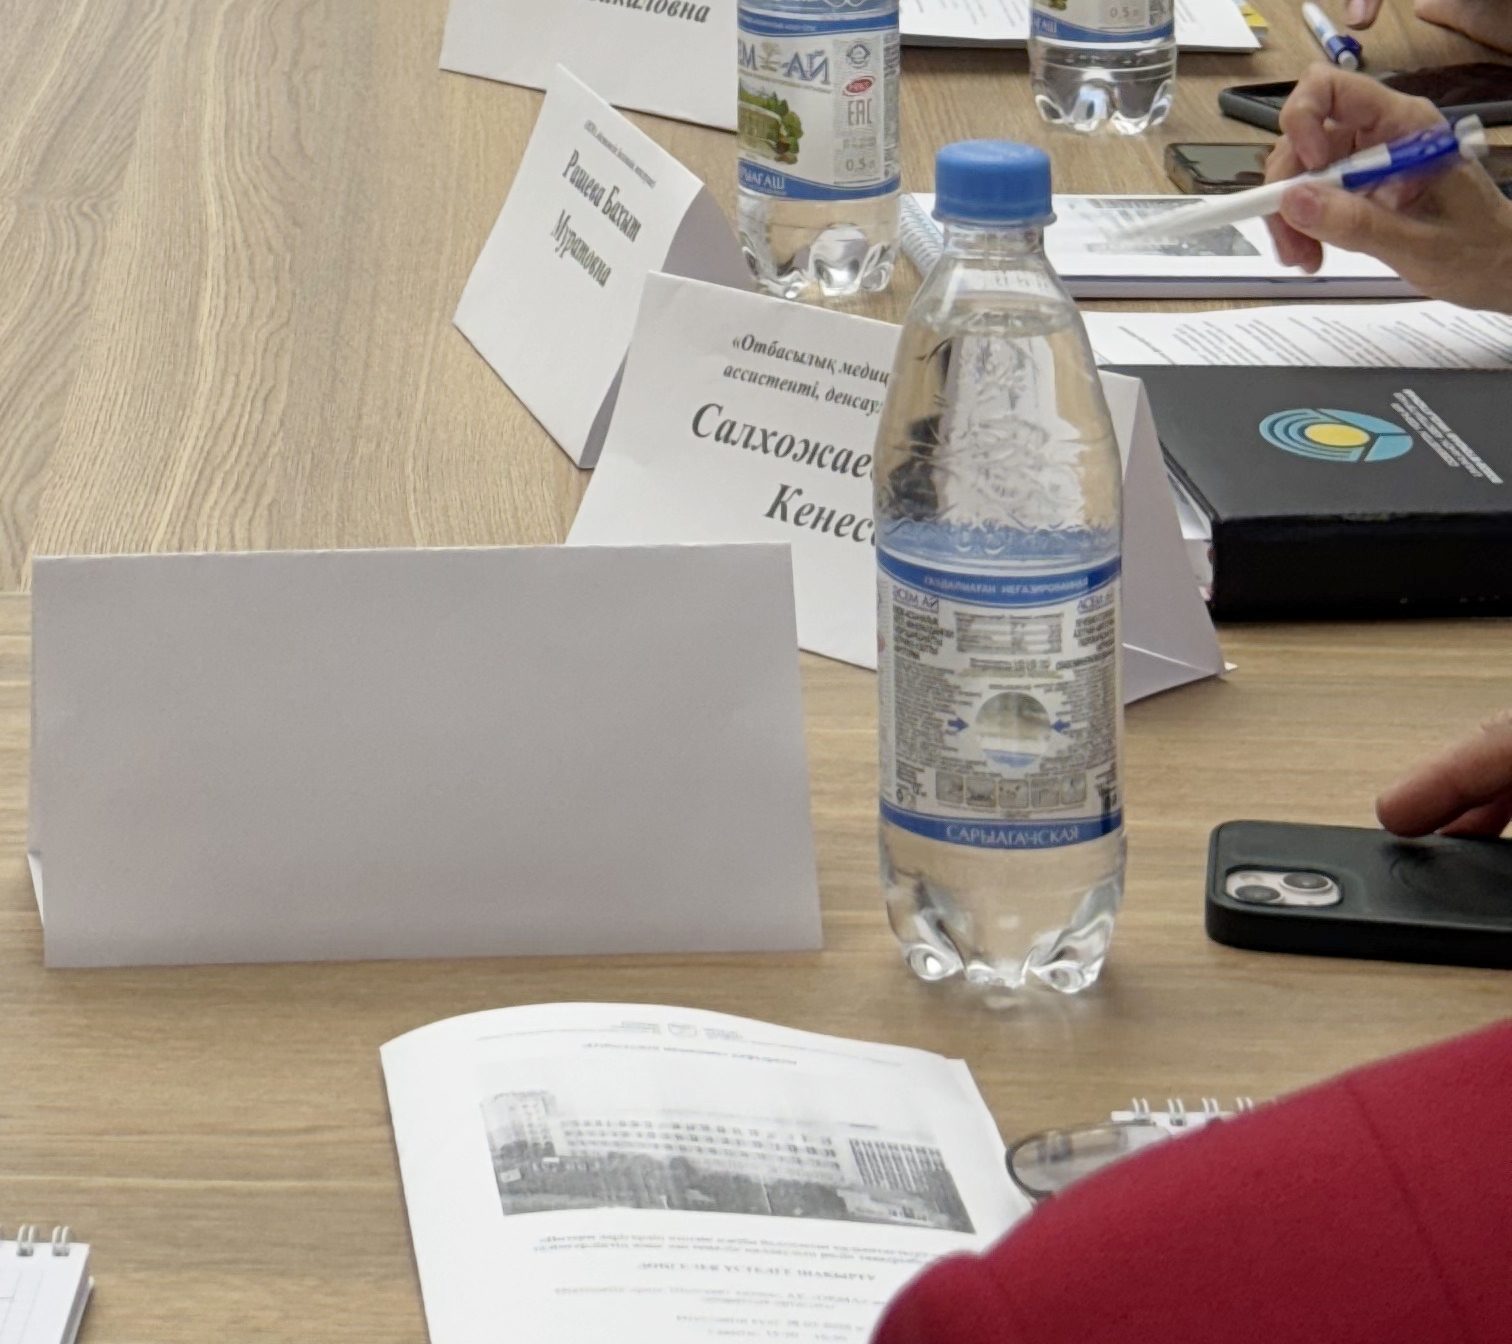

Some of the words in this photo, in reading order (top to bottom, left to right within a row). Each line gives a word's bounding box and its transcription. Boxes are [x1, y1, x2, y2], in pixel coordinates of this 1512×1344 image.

[550, 208, 613, 289] Муратовна
[732, 333, 837, 375] «Отбасылық
[837, 361, 890, 388] медиц
[691, 402, 875, 479] Салхожае
[947, 823, 1080, 846] САРЫАГАЧСКАЯ
